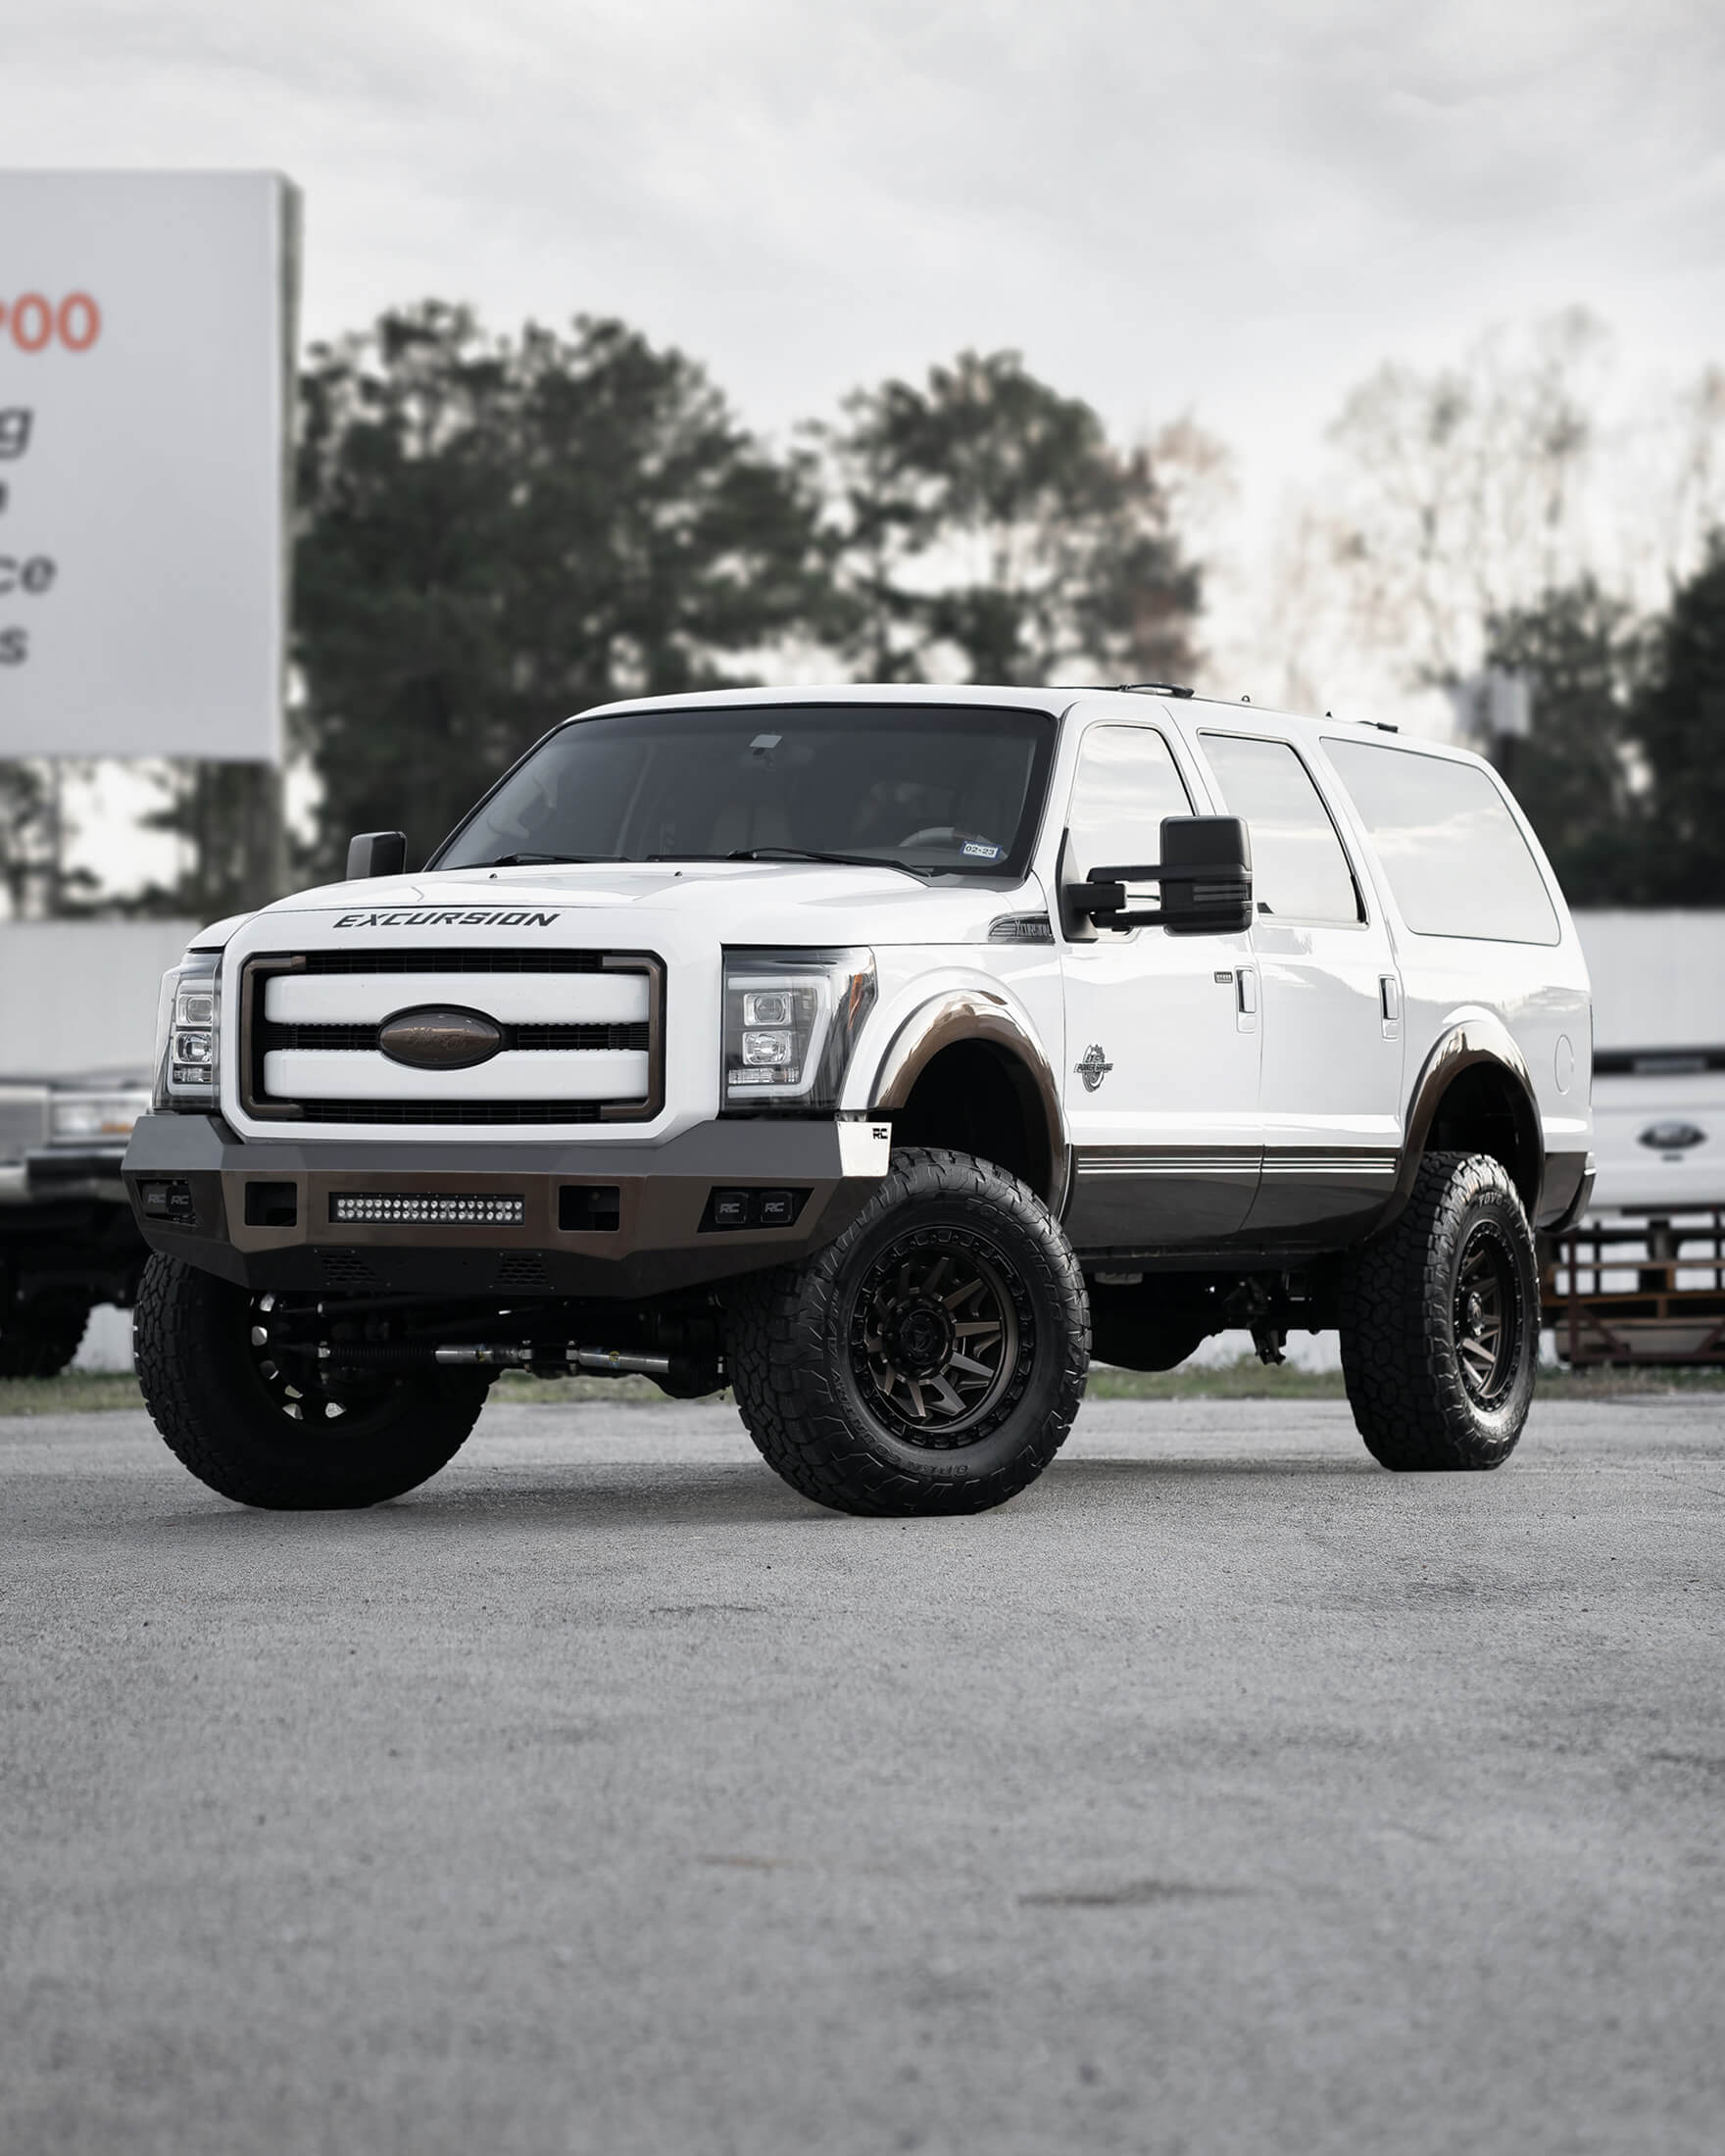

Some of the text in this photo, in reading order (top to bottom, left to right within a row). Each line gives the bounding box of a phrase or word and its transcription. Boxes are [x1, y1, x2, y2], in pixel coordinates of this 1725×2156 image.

[0, 291, 102, 354] 00
[333, 911, 561, 928] EXCURSION
[172, 1195, 189, 1205] RC
[1478, 1191, 1503, 1207] TOYO
[719, 1202, 740, 1213] RC
[764, 1201, 785, 1213] RC
